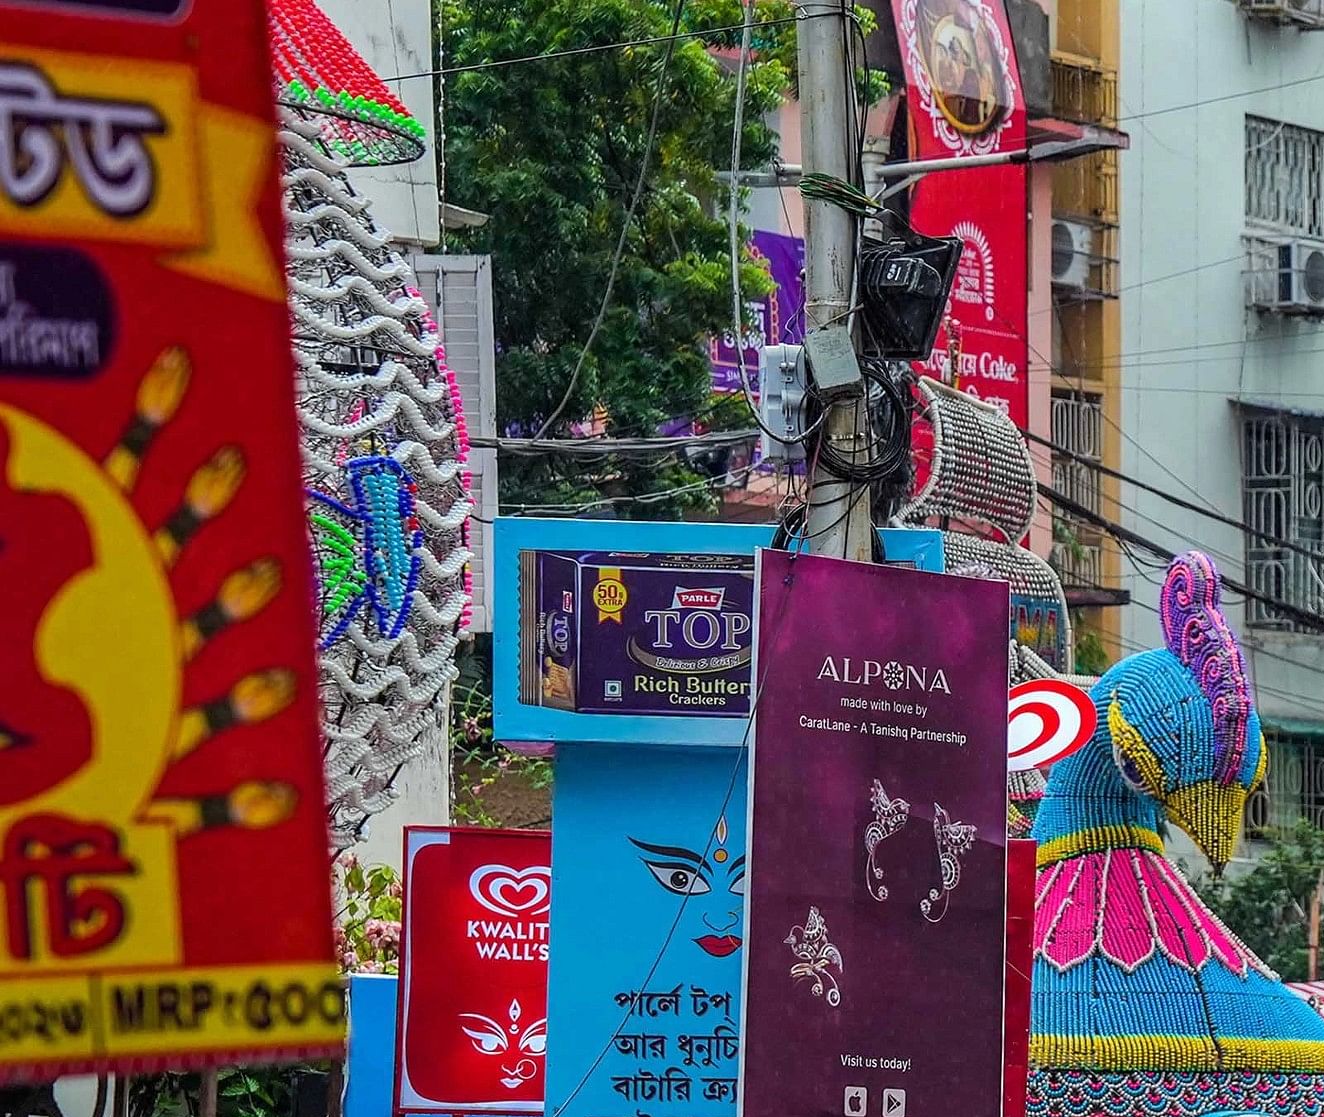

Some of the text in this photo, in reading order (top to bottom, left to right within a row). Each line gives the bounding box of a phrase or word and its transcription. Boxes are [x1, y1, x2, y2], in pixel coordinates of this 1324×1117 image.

[598, 599, 623, 607] EXTRA
[681, 594, 718, 603] PARLE
[645, 611, 750, 650] TOP
[816, 655, 952, 694] ALPONA
[634, 676, 751, 694] Rich Butter
[669, 693, 726, 706] Crackers
[840, 696, 928, 718] made with love by
[799, 715, 851, 732] CaratLane
[860, 722, 868, 734] A
[870, 723, 908, 740] Tanishq
[910, 727, 967, 747] Partnership
[467, 920, 550, 940] KWALIT
[476, 941, 550, 961] WALL'S
[614, 1033, 668, 1059] আর
[841, 1054, 911, 1072] Visit us today!
[611, 1068, 692, 1102] বাটারি
